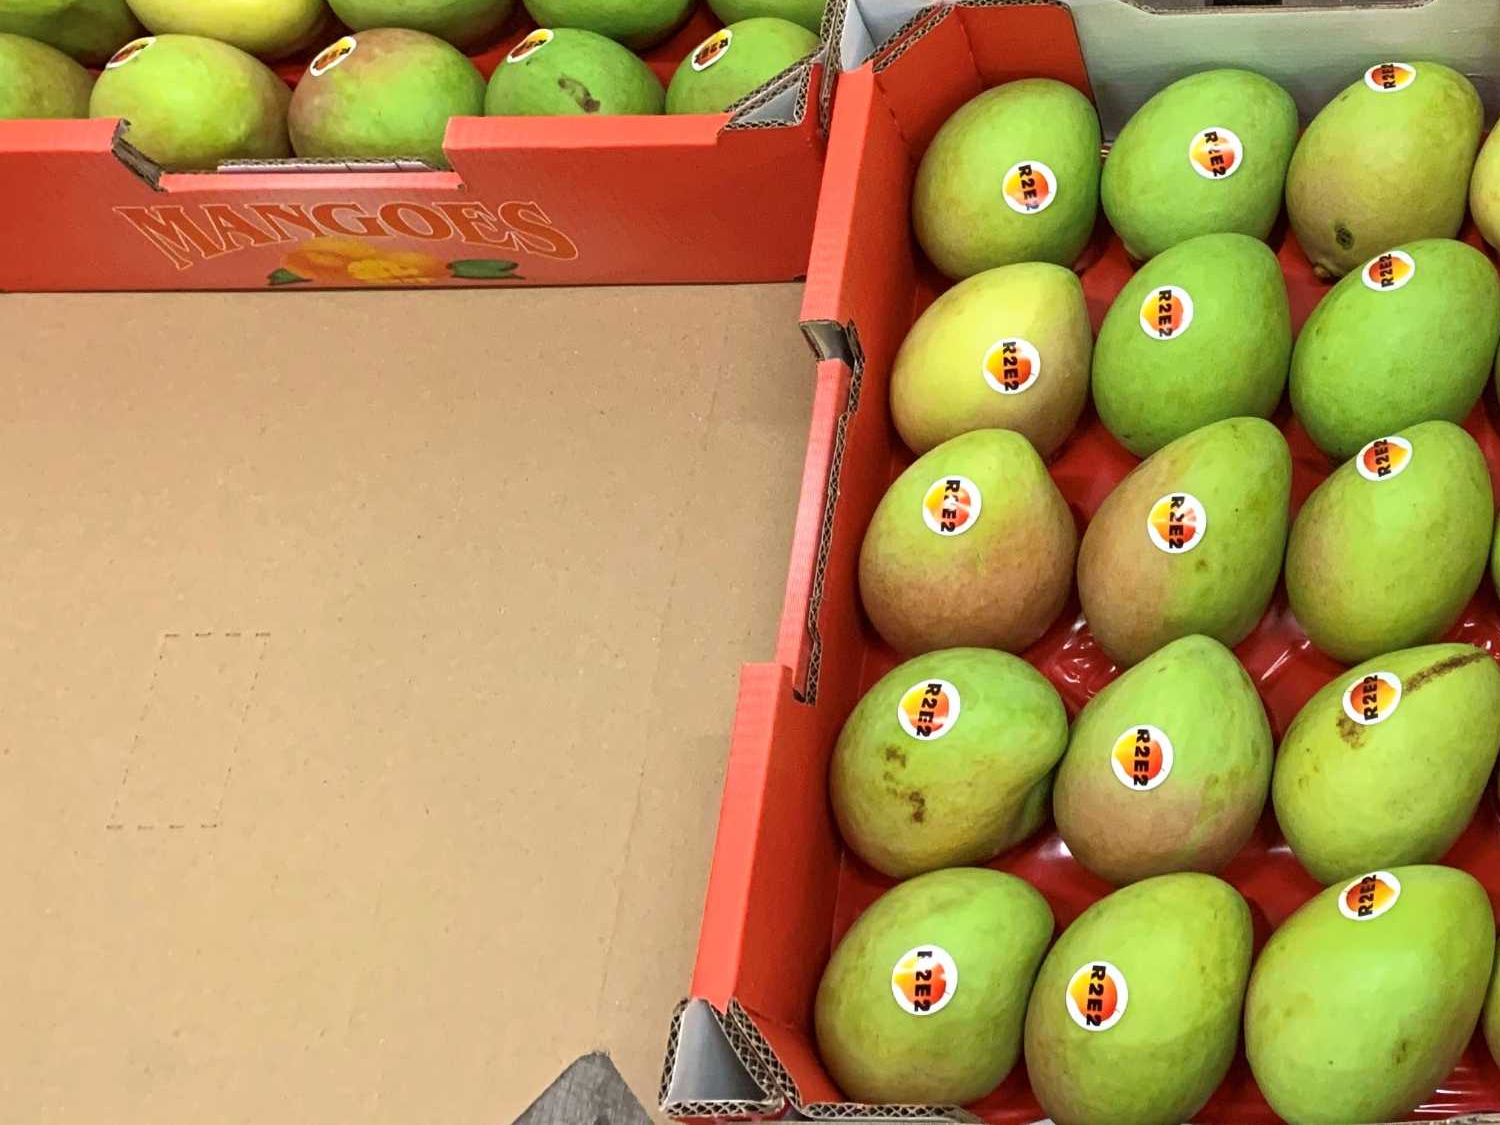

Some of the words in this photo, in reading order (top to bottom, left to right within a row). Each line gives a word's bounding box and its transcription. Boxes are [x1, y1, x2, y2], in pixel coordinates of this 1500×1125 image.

[1380, 63, 1396, 90] R2E2
[113, 200, 580, 270] MANGOES
[1377, 253, 1394, 288] R2E2
[1158, 289, 1173, 337] R2E2
[1002, 341, 1020, 392] R2E2
[1373, 439, 1392, 478] R2E2
[916, 683, 943, 738] R2E2
[1362, 674, 1378, 721] R2E2
[1133, 728, 1151, 787] R2E2
[1357, 874, 1377, 917] R2E2
[1085, 965, 1107, 1027] R2E2
